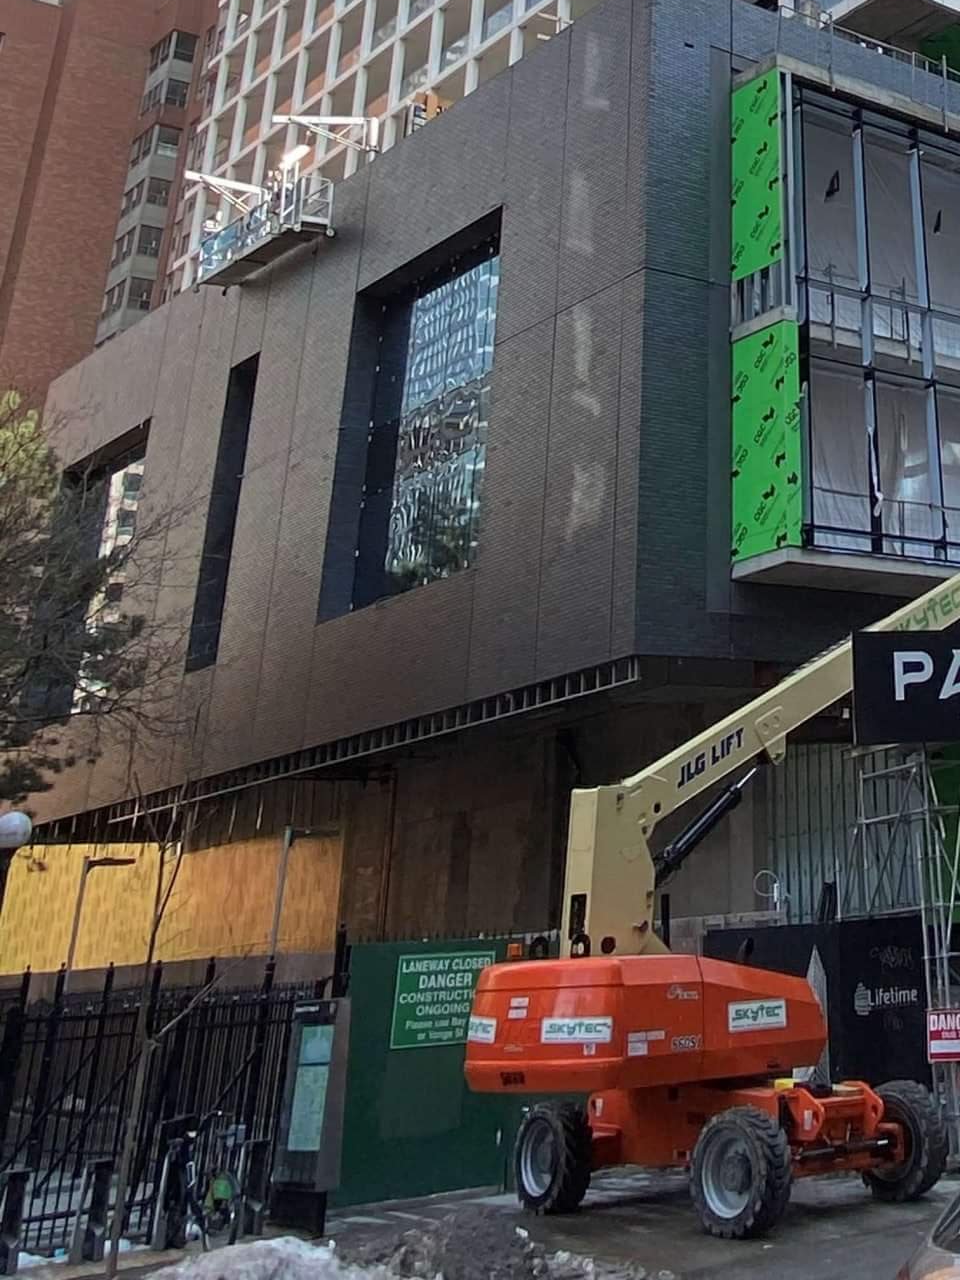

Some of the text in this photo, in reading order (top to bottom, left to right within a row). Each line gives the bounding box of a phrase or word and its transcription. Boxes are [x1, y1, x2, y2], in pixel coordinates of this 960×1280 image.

[677, 727, 745, 789] JLG LIFT
[402, 957, 491, 973] LANEWAY CLOSED
[418, 972, 473, 989] DANGER
[400, 989, 476, 1004] CONSTRUCTI
[867, 986, 918, 1006] Lifetime
[415, 1003, 470, 1016] ONGOING
[731, 1003, 783, 1022] SKYTEC
[545, 1022, 612, 1036] SKYTEC
